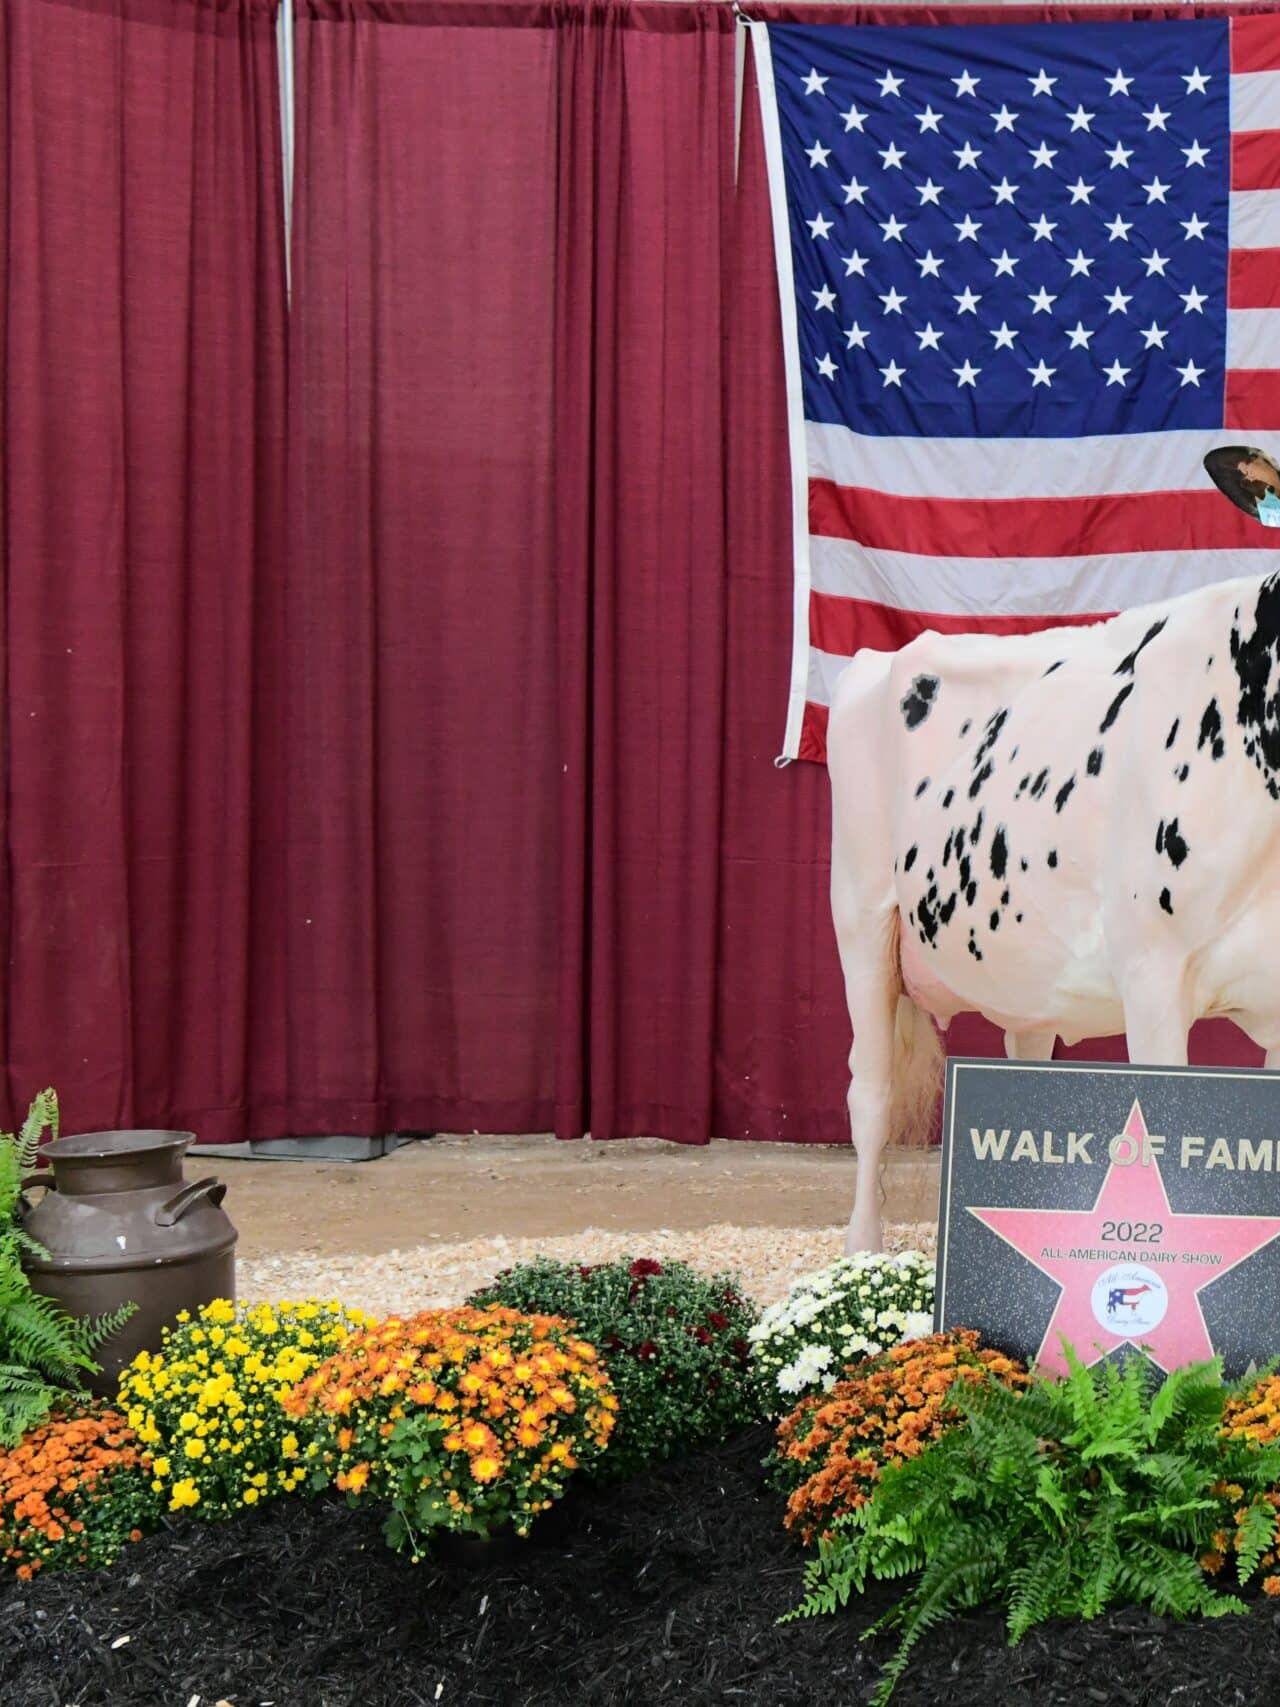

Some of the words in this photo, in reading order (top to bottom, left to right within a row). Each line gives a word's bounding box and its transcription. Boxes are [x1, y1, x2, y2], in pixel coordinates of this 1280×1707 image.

[970, 1128, 1094, 1164] WALK
[1108, 1134, 1166, 1168] OF
[1101, 1221, 1163, 1243] 2022
[1040, 1247, 1137, 1262] ALL-AMERICAN
[1140, 1252, 1178, 1263] DAIRY
[1182, 1253, 1222, 1265] SHOW
